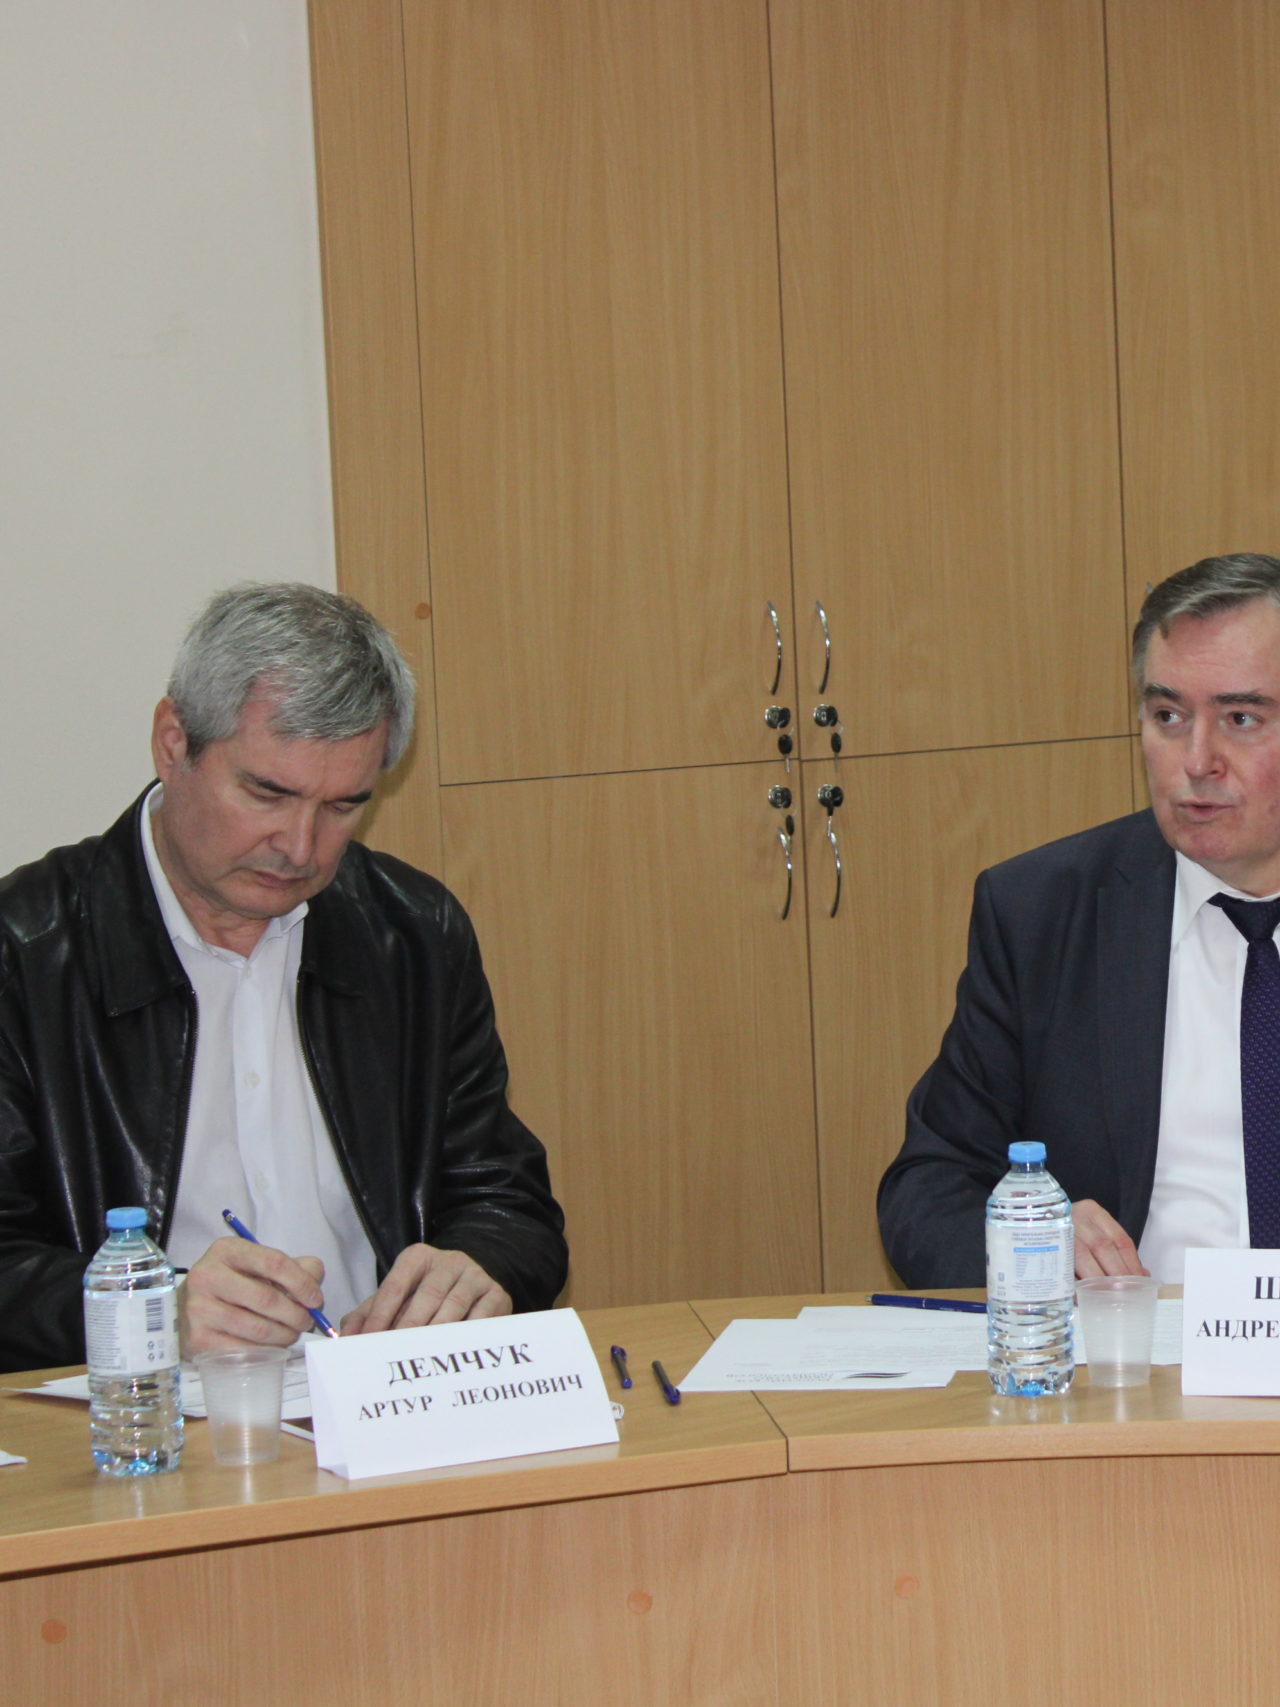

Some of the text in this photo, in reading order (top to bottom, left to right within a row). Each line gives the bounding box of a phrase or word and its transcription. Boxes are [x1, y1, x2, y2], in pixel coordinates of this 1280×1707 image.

[388, 1343, 533, 1386] ДЕМЧУК
[358, 1373, 584, 1421] АРТУР ЛЕОНОВИЧ
